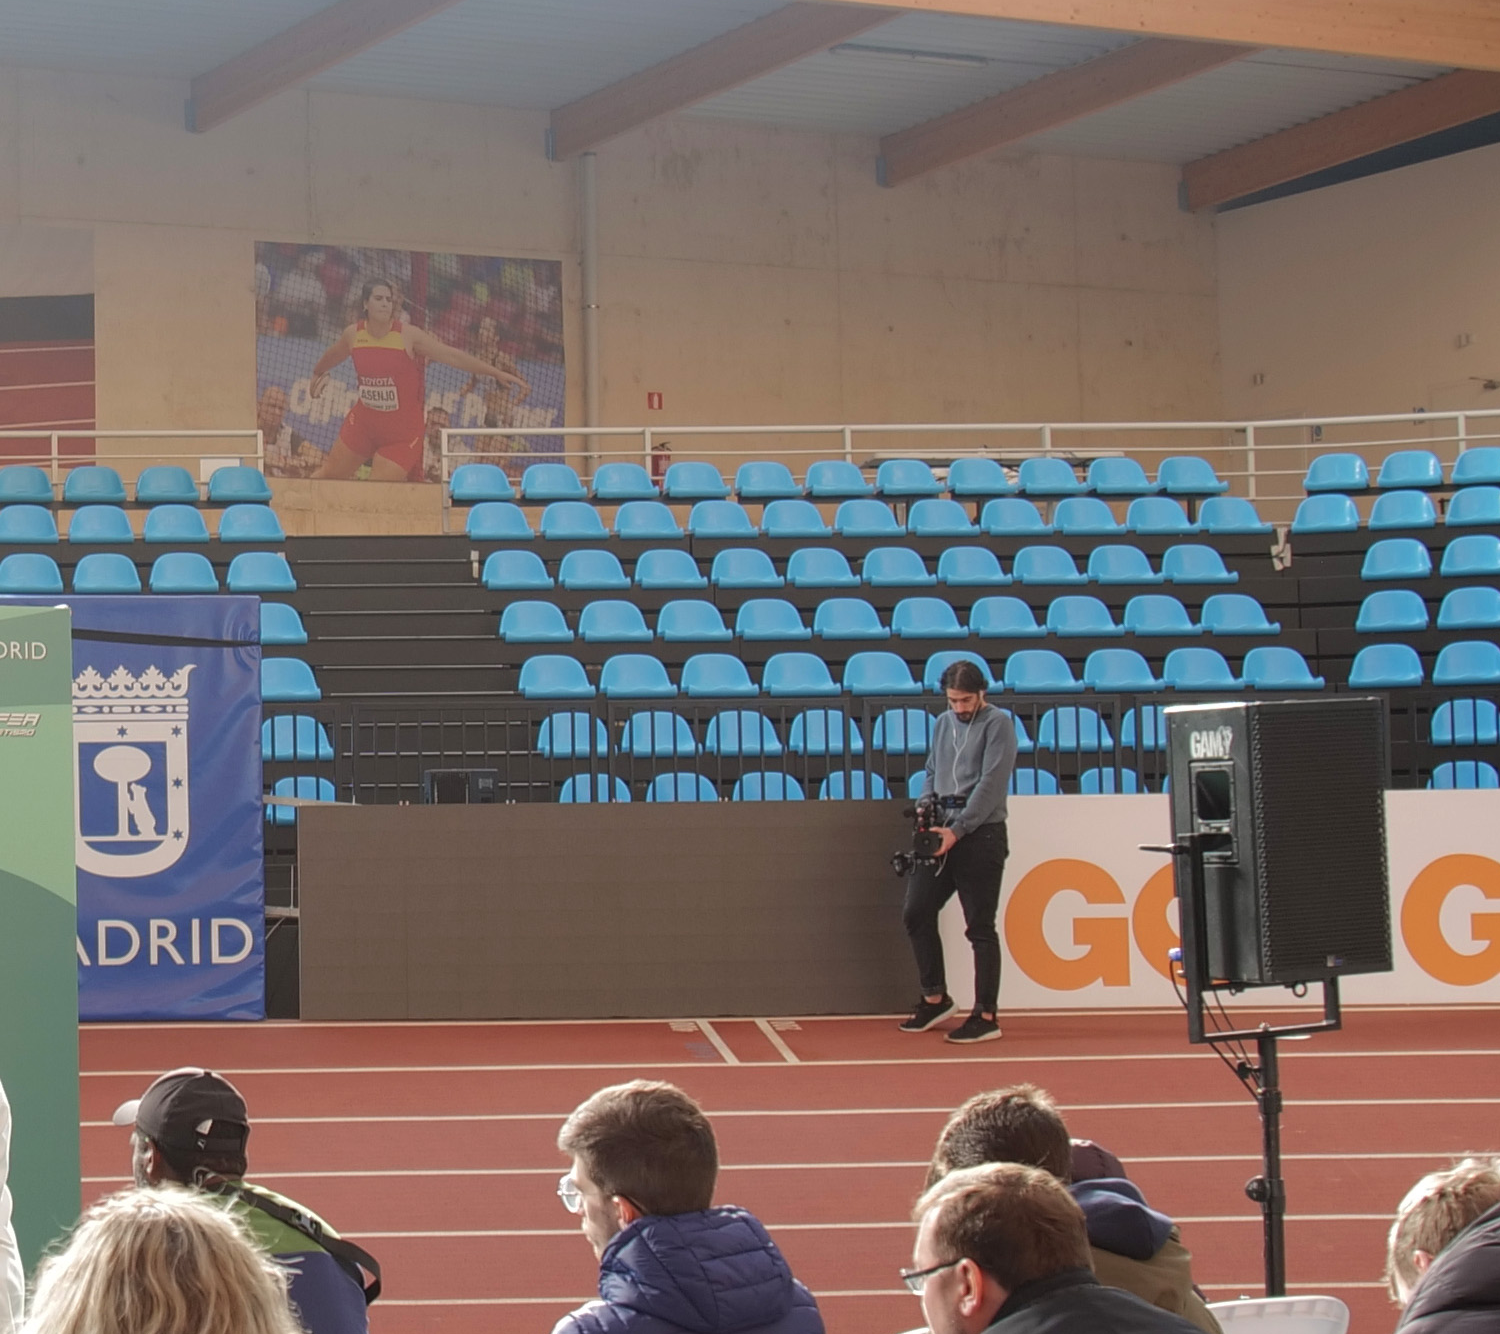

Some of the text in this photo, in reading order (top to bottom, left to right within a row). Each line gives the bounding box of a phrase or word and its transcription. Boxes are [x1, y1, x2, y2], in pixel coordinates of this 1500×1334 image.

[361, 376, 395, 386] TOYOTA
[361, 387, 395, 402] ASENJO
[77, 917, 254, 967] DRID
